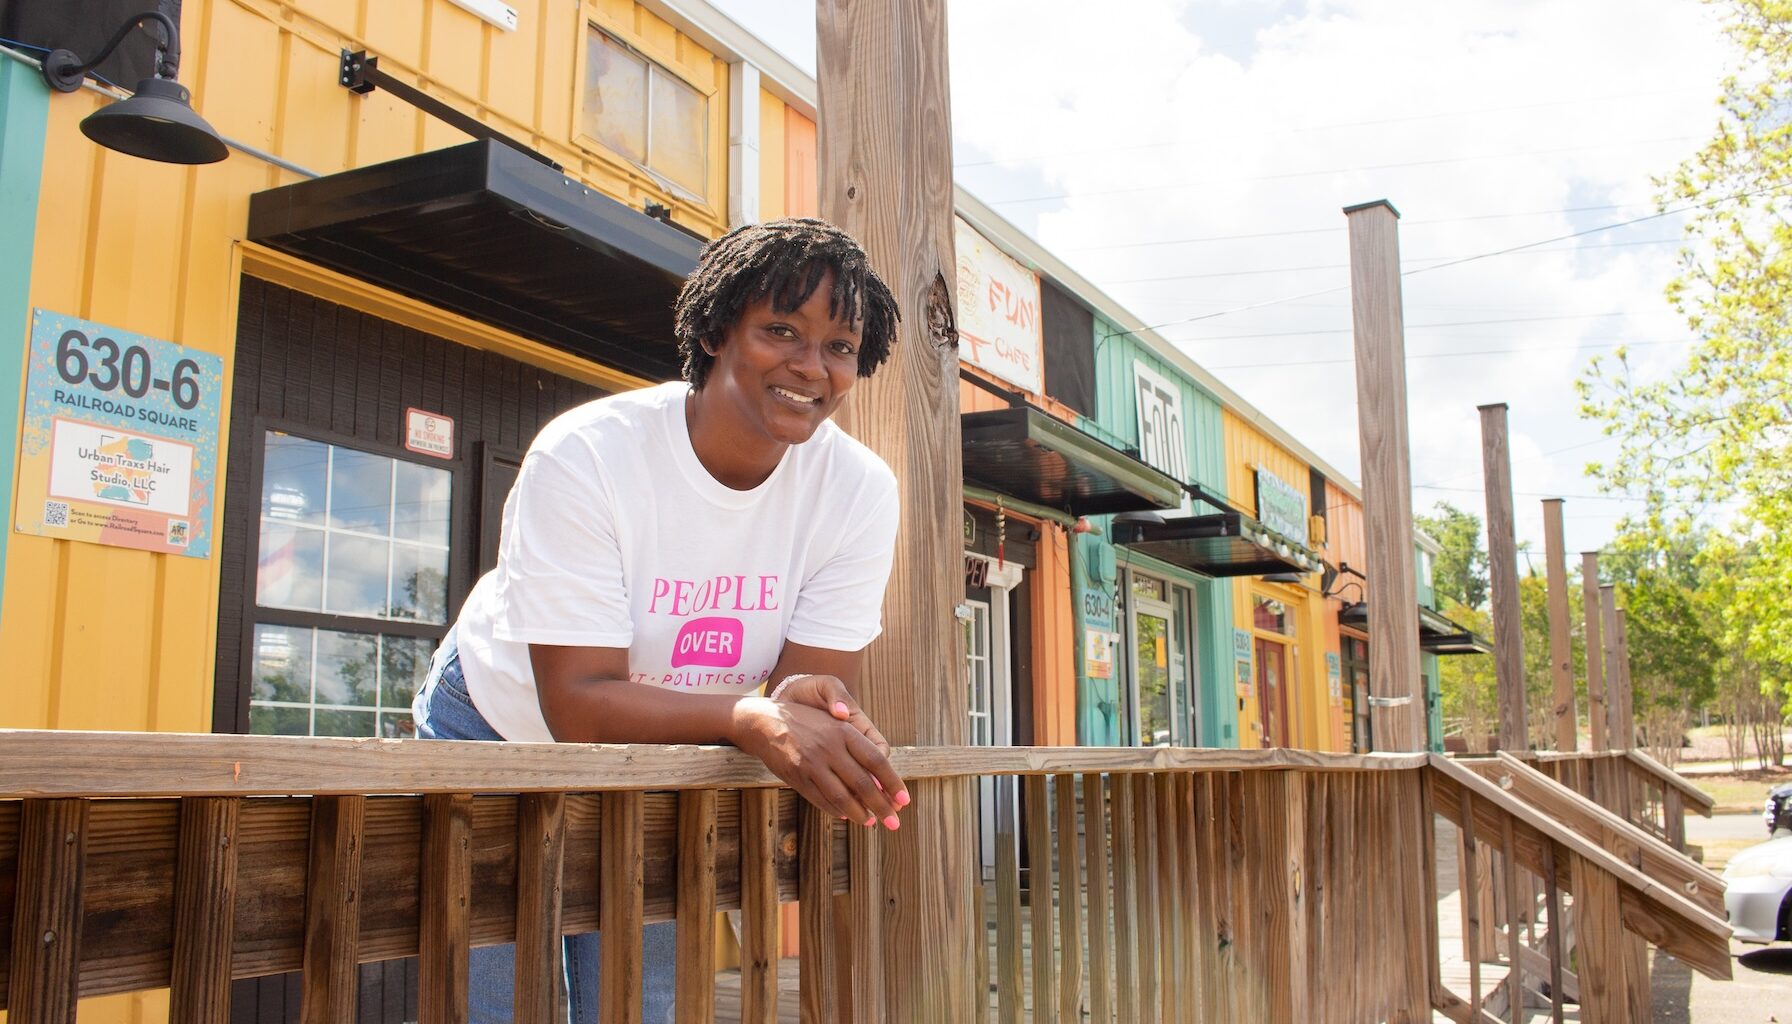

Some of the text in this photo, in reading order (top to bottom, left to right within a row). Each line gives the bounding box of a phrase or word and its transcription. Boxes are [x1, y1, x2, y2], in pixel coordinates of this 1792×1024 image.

[988, 274, 1034, 333] FUN
[995, 336, 1031, 371] CAFE
[56, 329, 201, 410] 630-6
[54, 389, 198, 432] RAILROAD SQUARE
[78, 447, 171, 475] Urban Traxs Hair
[90, 469, 157, 491] Studio, LLC
[71, 509, 86, 517] Scan
[112, 515, 138, 525] Directory
[965, 556, 989, 588] PEN
[648, 575, 779, 617] PEOPLE
[1085, 593, 1110, 619] 630-4
[680, 630, 734, 655] OVER
[661, 671, 745, 687] POLITICS
